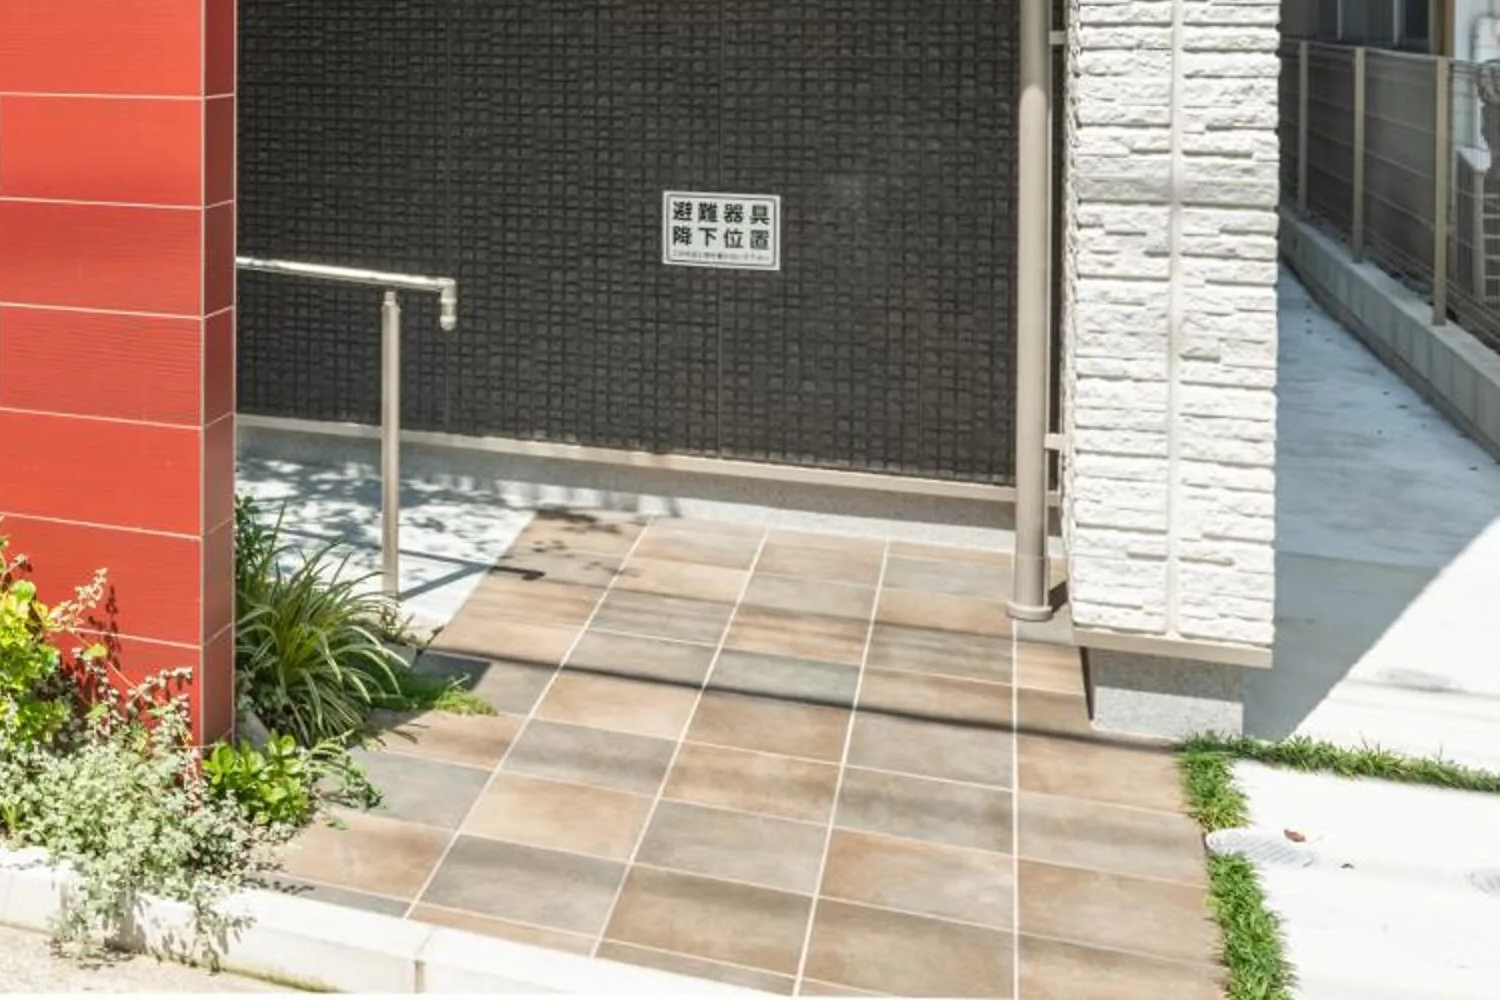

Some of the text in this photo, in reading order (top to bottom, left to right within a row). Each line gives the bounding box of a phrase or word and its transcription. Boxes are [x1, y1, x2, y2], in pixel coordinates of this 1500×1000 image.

[672, 201, 771, 225] 避難器具
[672, 226, 770, 250] 降下位置
